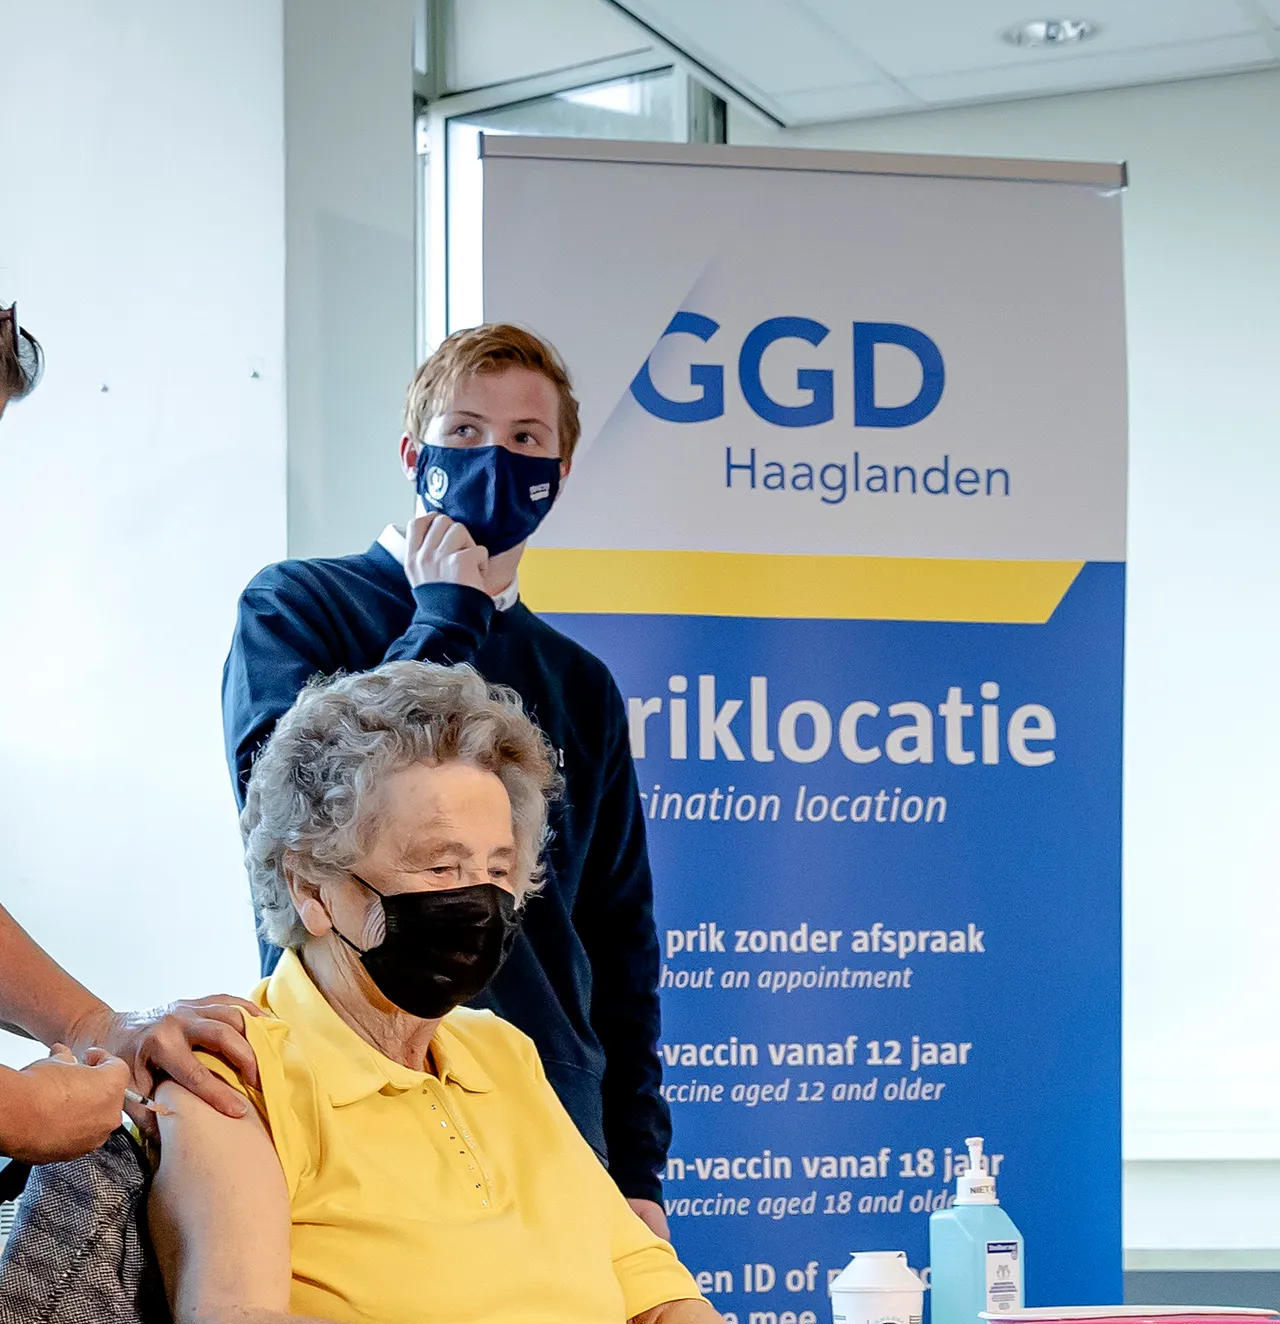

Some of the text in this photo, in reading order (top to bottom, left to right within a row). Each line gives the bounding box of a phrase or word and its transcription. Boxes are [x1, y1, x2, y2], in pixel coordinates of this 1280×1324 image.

[629, 311, 946, 429] GGD
[725, 447, 1011, 505] Haaglanden
[639, 784, 948, 824] ination location
[666, 922, 986, 959] prik zonder afspraak
[721, 970, 750, 989] an
[757, 965, 913, 994] appointment
[767, 1035, 859, 1066] vanaf
[866, 1040, 902, 1065] 12
[910, 1035, 973, 1072] jaar
[731, 1078, 790, 1107] aged
[796, 1081, 825, 1102] 12
[831, 1077, 878, 1102] and
[883, 1077, 946, 1102] older
[657, 1149, 792, 1180] n-vaccin
[801, 1147, 891, 1179] vanaf
[899, 1148, 935, 1178] 18
[663, 1193, 751, 1217] vaccine
[757, 1191, 817, 1220] aged
[823, 1191, 853, 1214] 18
[858, 1189, 904, 1214] and
[744, 1263, 776, 1293] ID
[785, 1261, 819, 1292] of
